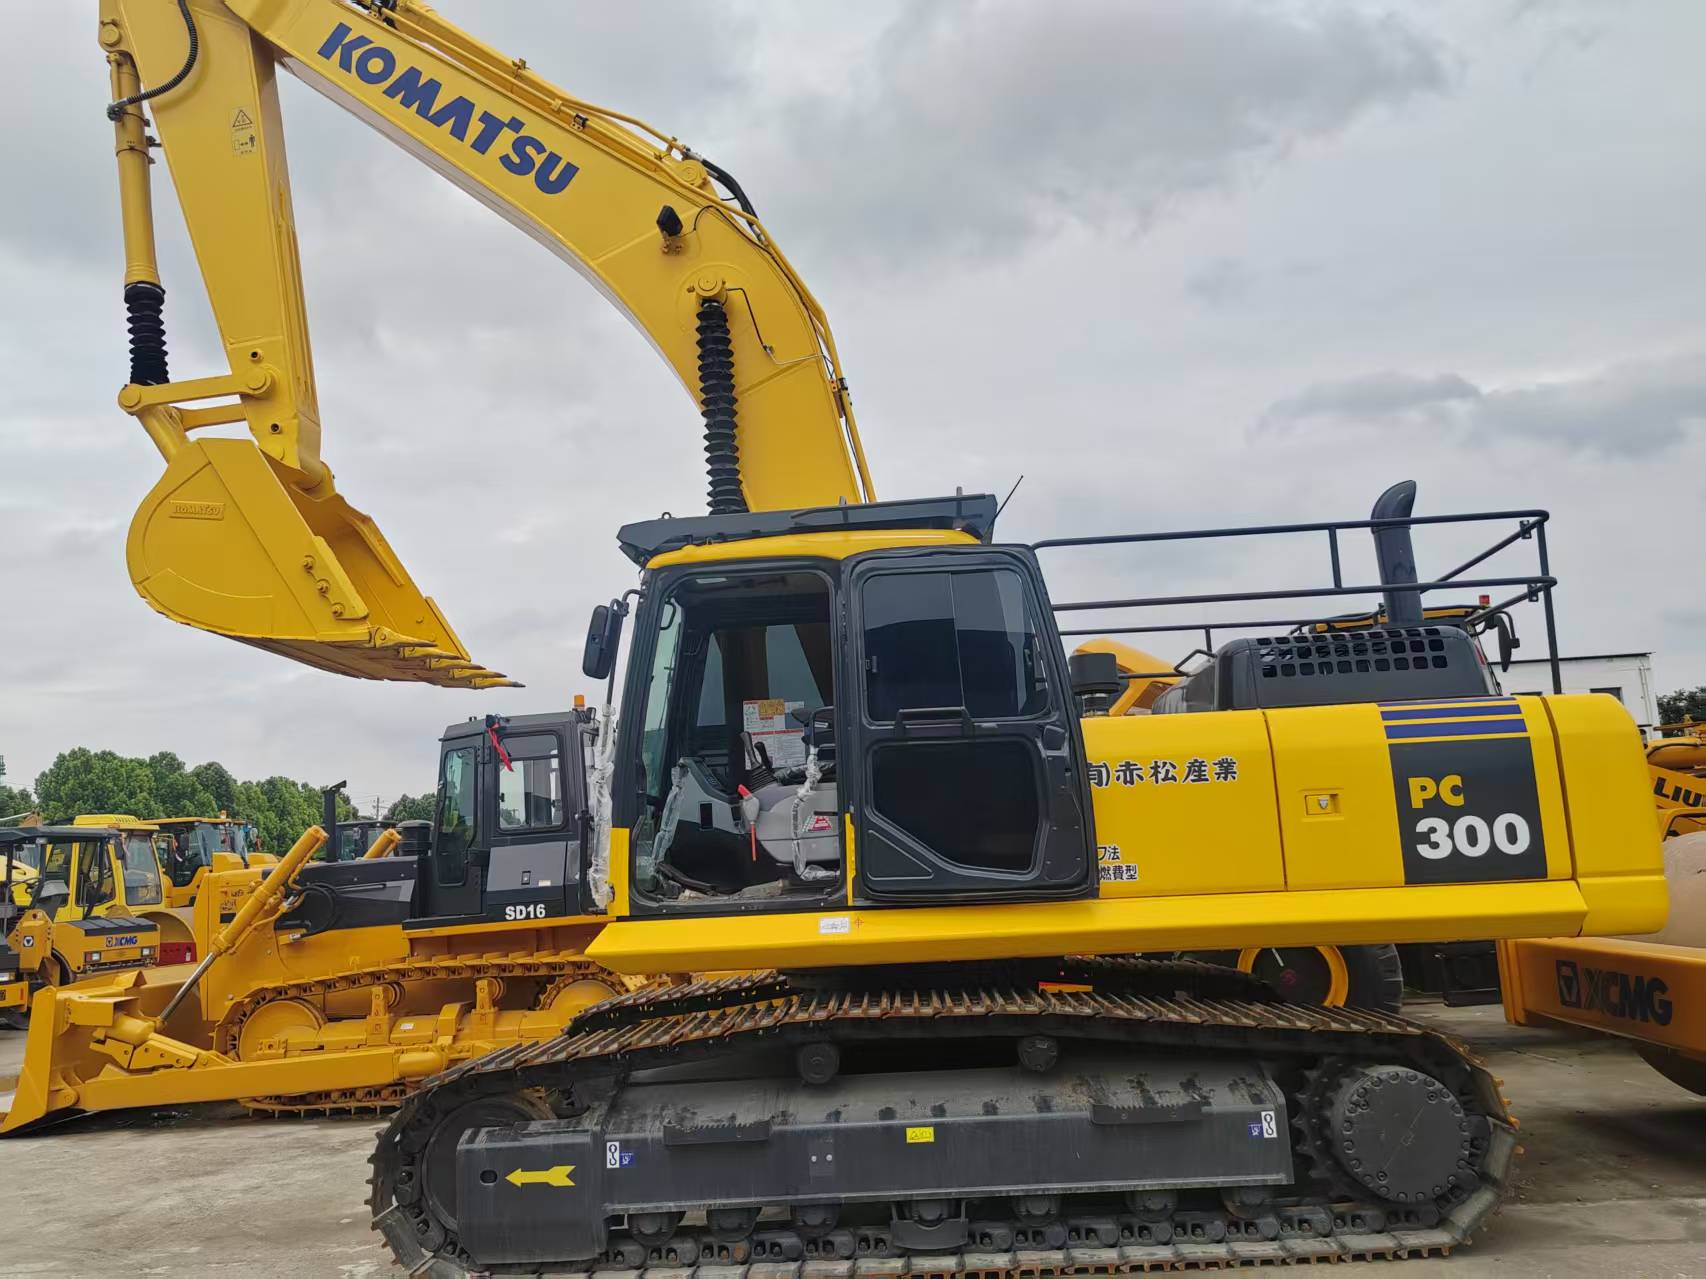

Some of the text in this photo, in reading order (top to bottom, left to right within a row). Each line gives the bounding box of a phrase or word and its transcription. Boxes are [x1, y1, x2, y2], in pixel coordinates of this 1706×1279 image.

[317, 22, 580, 195] KOMATSU
[1408, 774, 1465, 809] PC
[1653, 776, 1705, 808] LIU
[1415, 812, 1531, 860] 300
[504, 903, 546, 920] SD16
[1583, 967, 1673, 1026] XCMG
